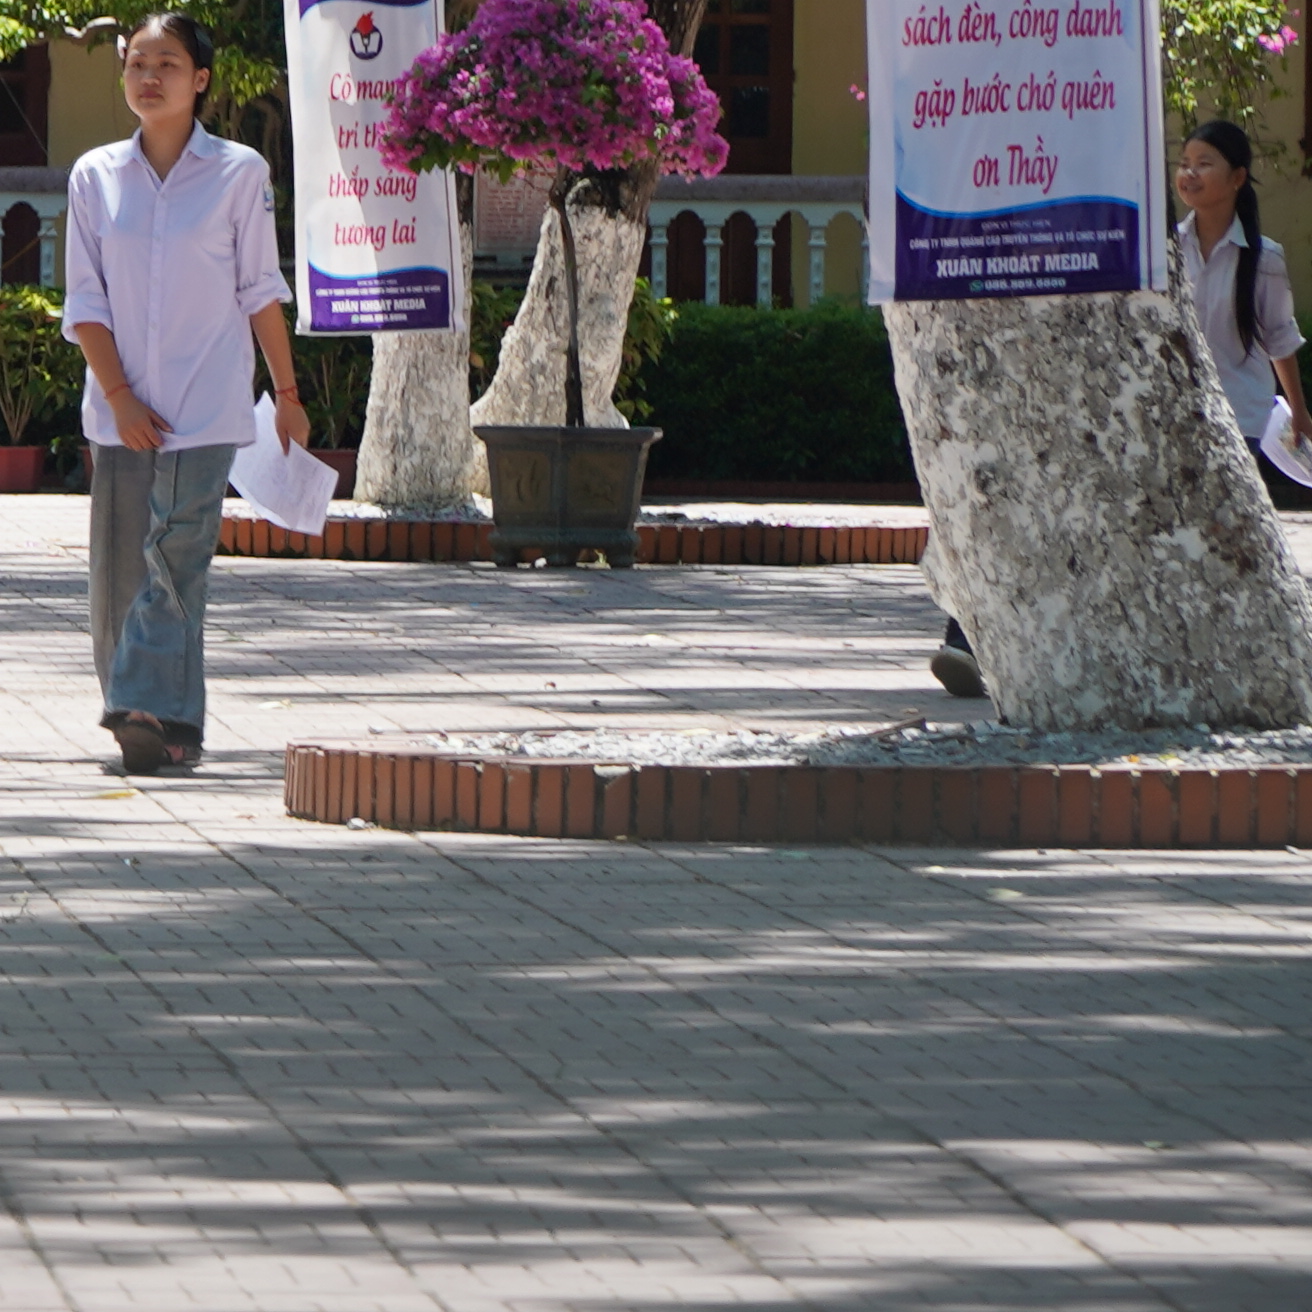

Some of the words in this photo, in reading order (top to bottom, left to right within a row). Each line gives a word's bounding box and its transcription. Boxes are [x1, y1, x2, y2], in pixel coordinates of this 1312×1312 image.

[902, 4, 953, 47] sách
[957, 0, 1002, 48] đèn,
[330, 71, 352, 101] Cô
[912, 78, 956, 129] gặp
[960, 72, 1012, 117] bước
[1016, 70, 1058, 112] chớ
[1060, 69, 1116, 120] quên
[972, 153, 1000, 188] ơn
[1005, 134, 1059, 195] Thầy
[329, 164, 370, 203] thắp
[373, 168, 418, 203] sáng
[334, 221, 387, 252] tương
[936, 255, 983, 278] XUÂN
[986, 253, 1041, 276] KHOÁT
[1044, 251, 1099, 272] MEDIA
[394, 296, 427, 312] MEDIA
